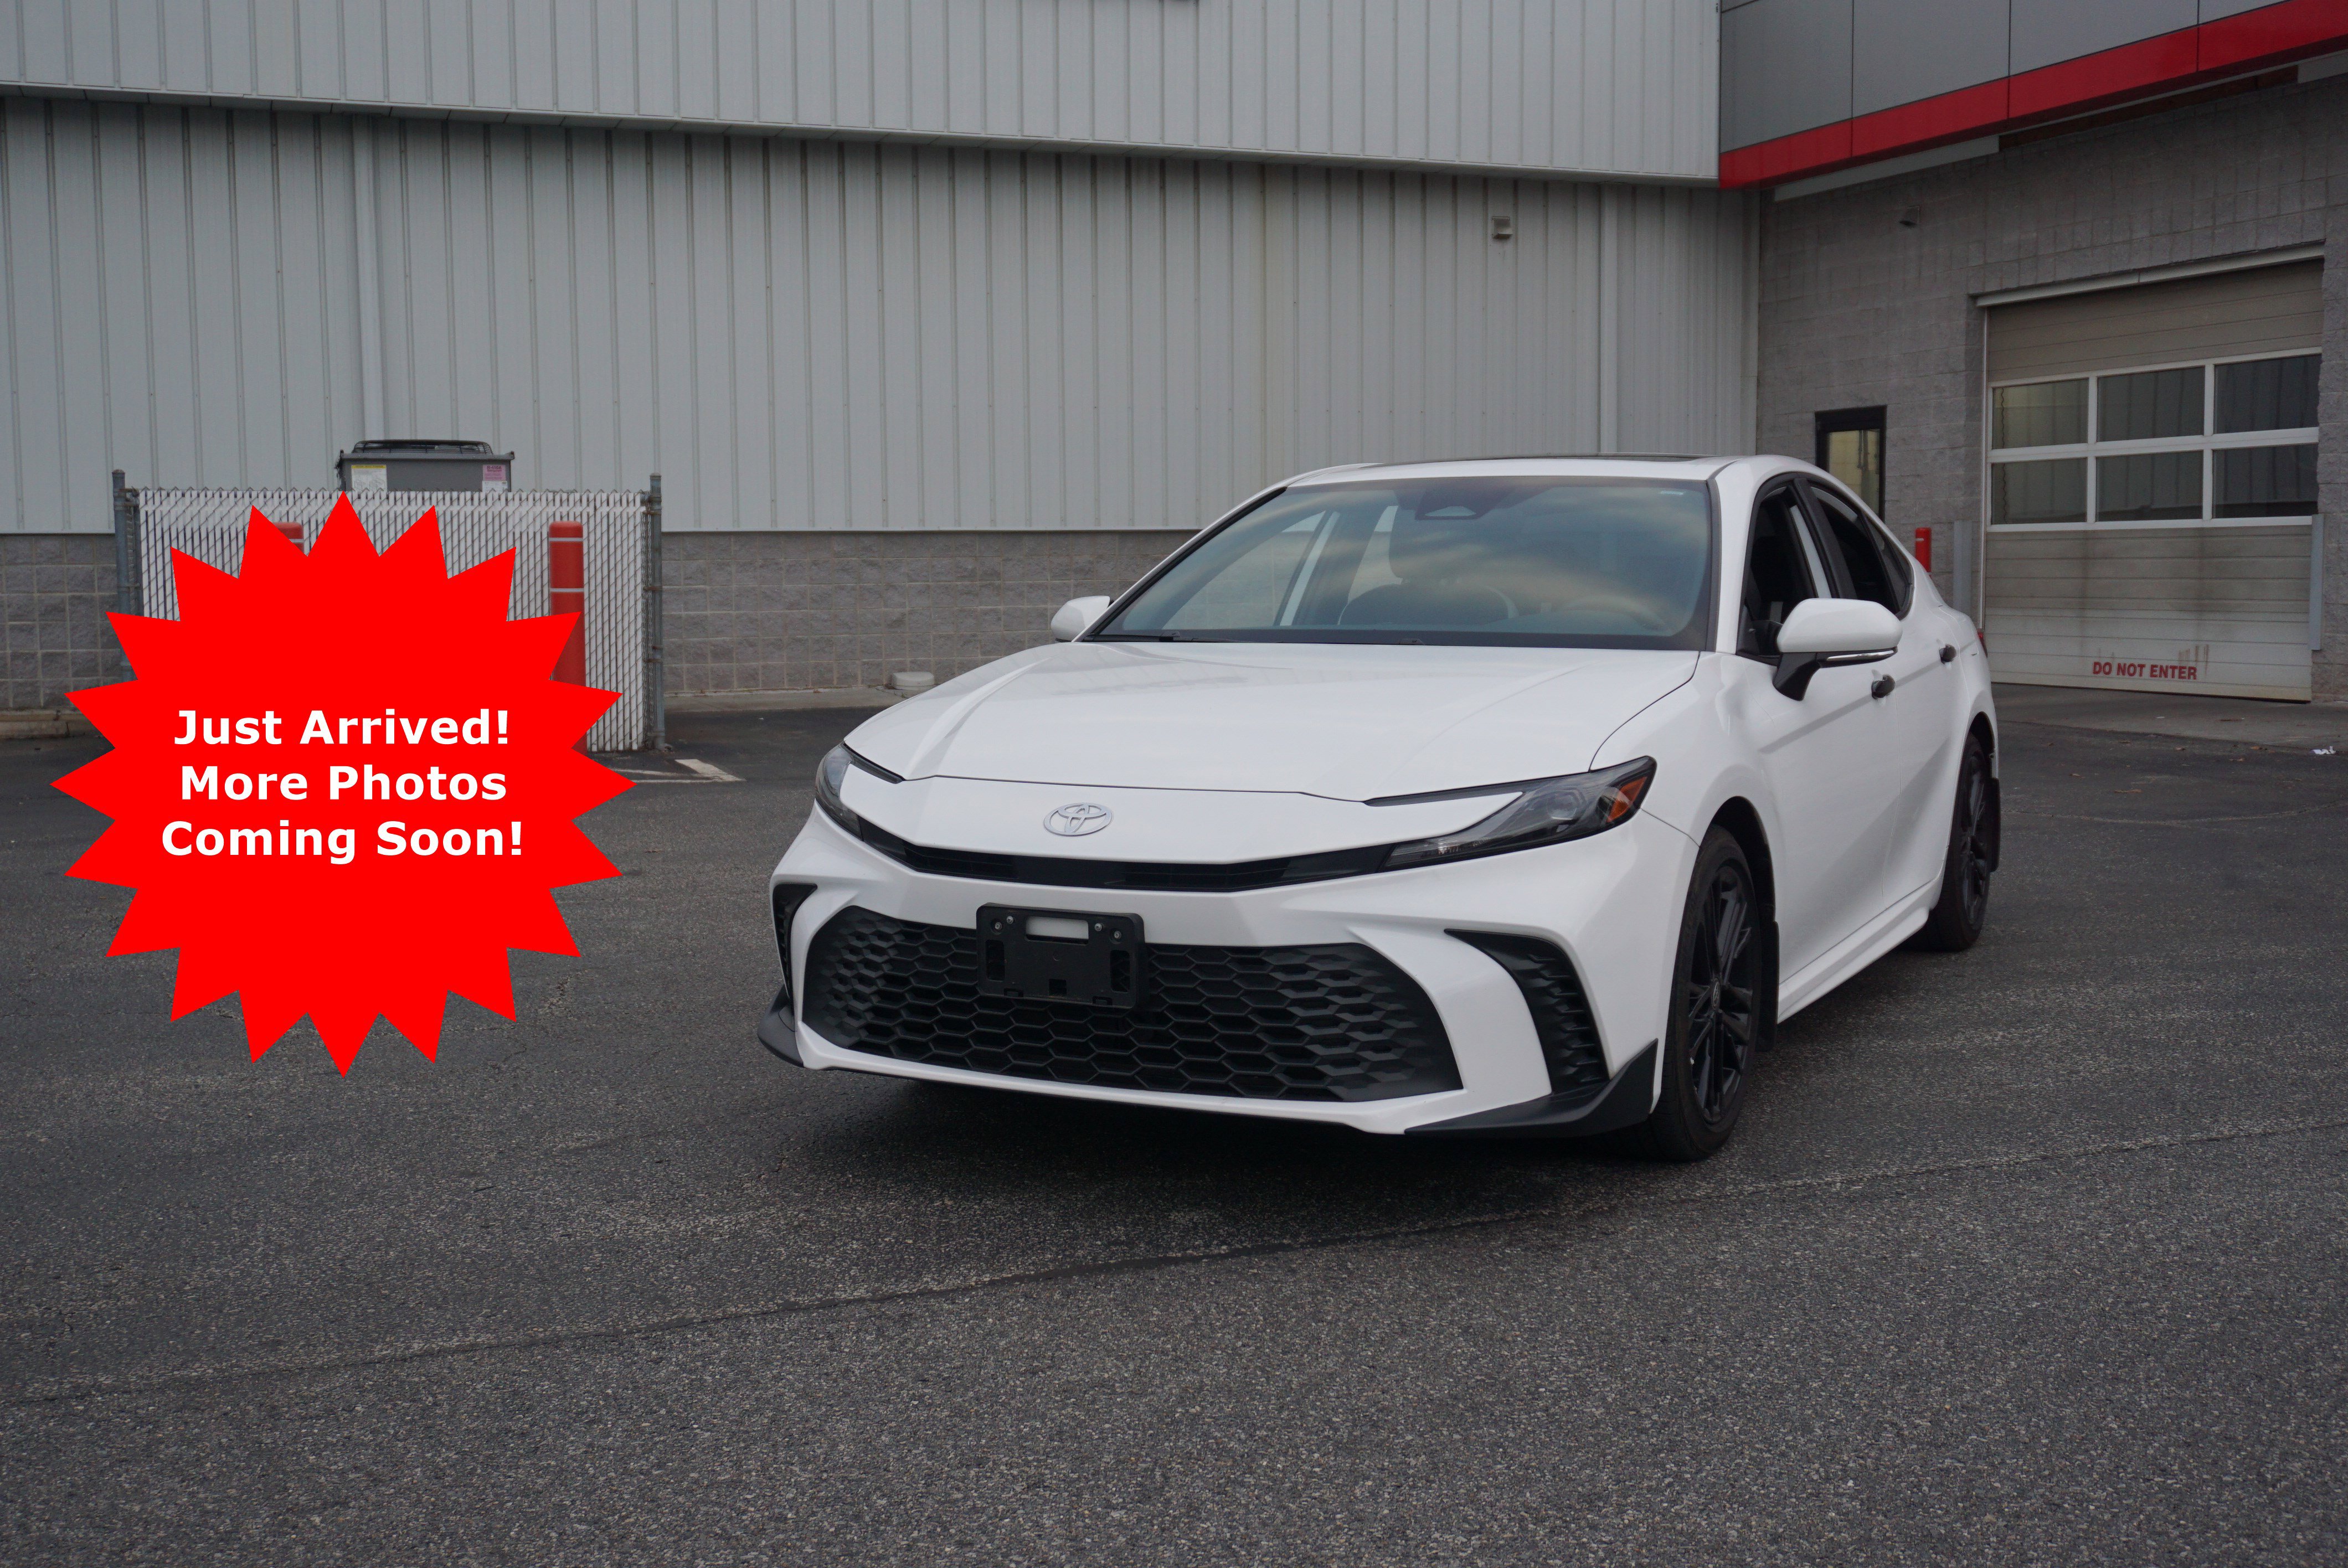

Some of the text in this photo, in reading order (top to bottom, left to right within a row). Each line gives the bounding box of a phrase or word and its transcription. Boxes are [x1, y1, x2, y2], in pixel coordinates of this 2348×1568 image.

[2093, 662, 2197, 679] DO NOT ENTER
